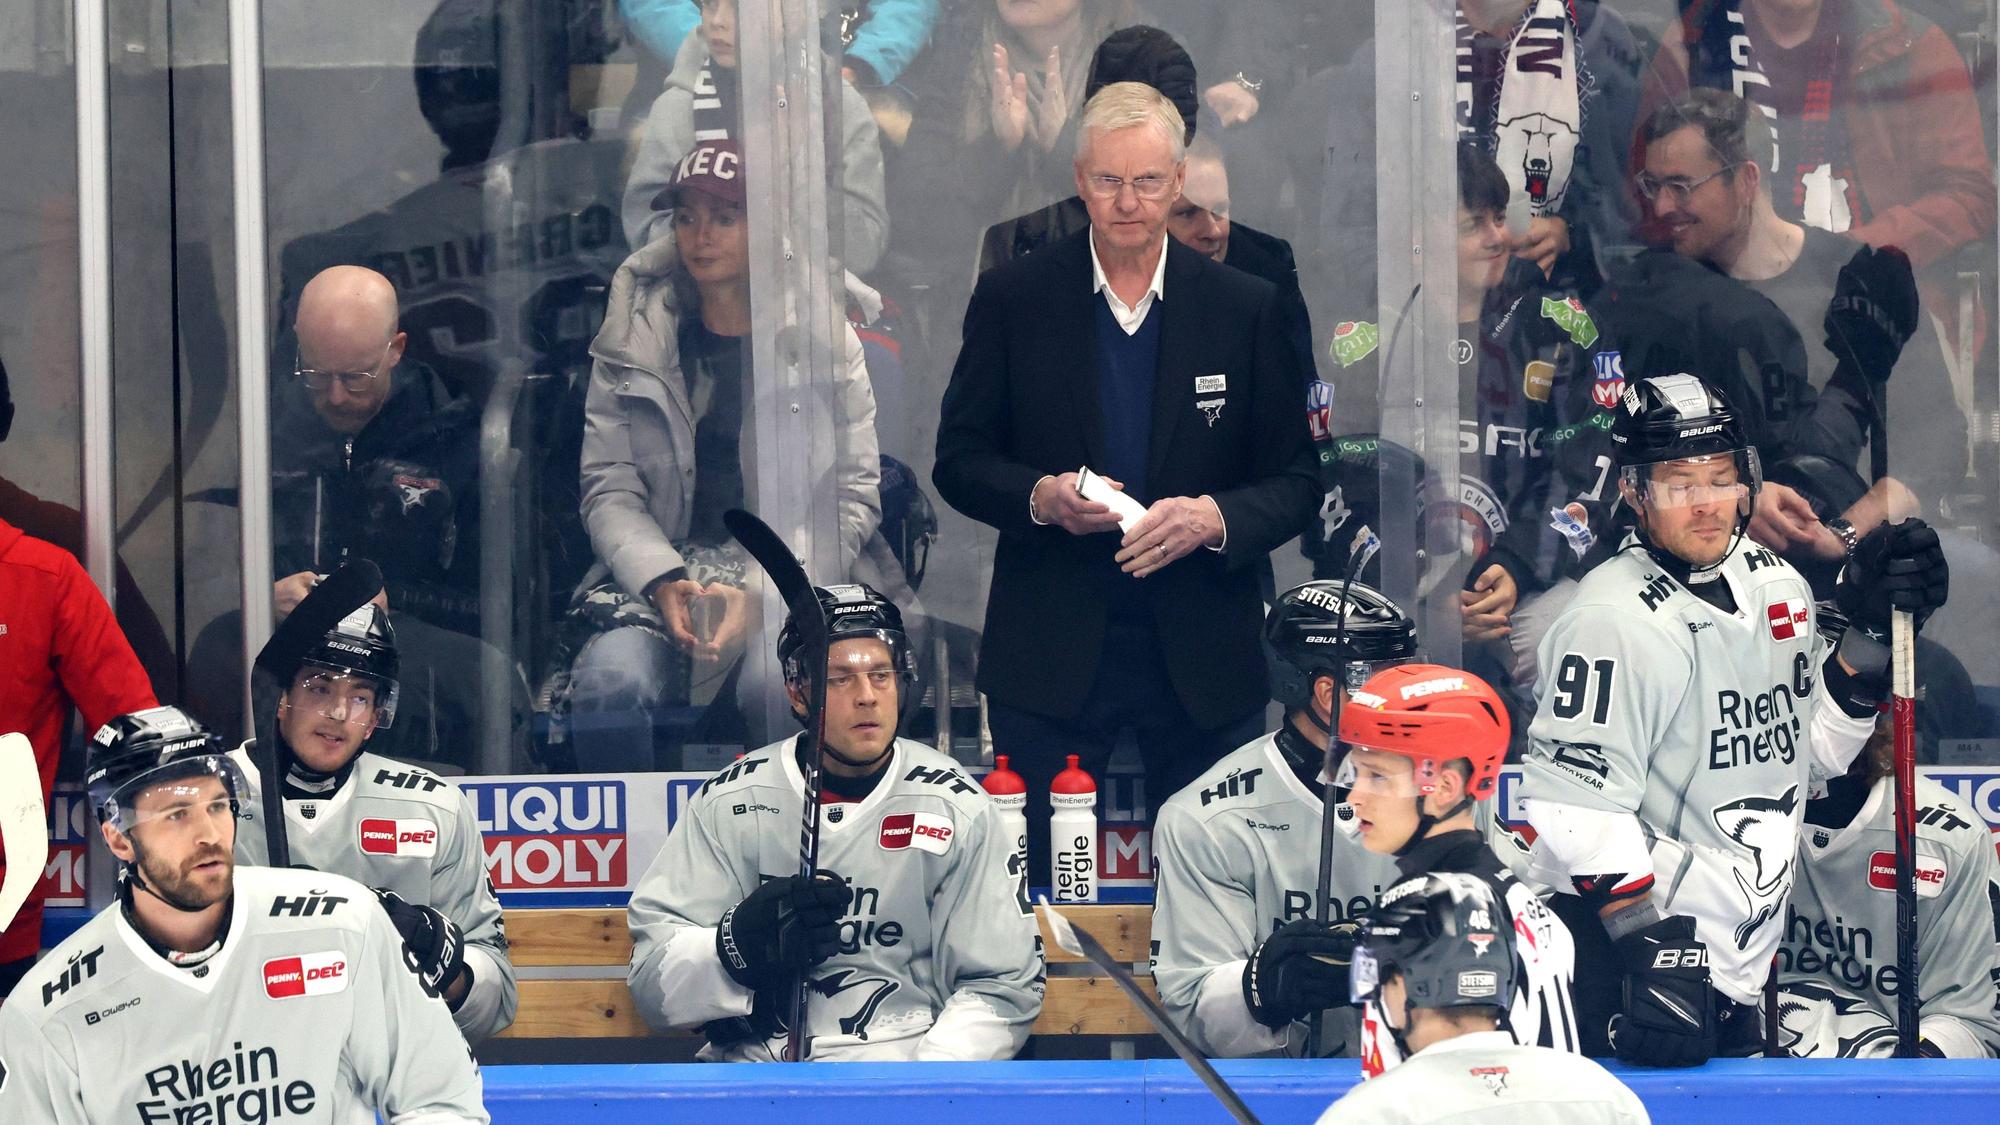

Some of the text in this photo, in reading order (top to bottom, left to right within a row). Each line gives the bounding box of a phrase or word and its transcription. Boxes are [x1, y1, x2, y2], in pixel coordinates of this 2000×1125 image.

[676, 147, 739, 183] KEC
[1679, 424, 1723, 438] BAUER
[833, 605, 877, 614] BAUER
[327, 641, 372, 657] BAUER
[1552, 651, 1617, 728] 91
[466, 786, 618, 834] LIQUI
[484, 838, 624, 885] MOLY
[1055, 851, 1072, 902] hein
[1469, 910, 1492, 930] 46
[1787, 902, 1873, 959] hein
[145, 1041, 279, 1101] Rhein
